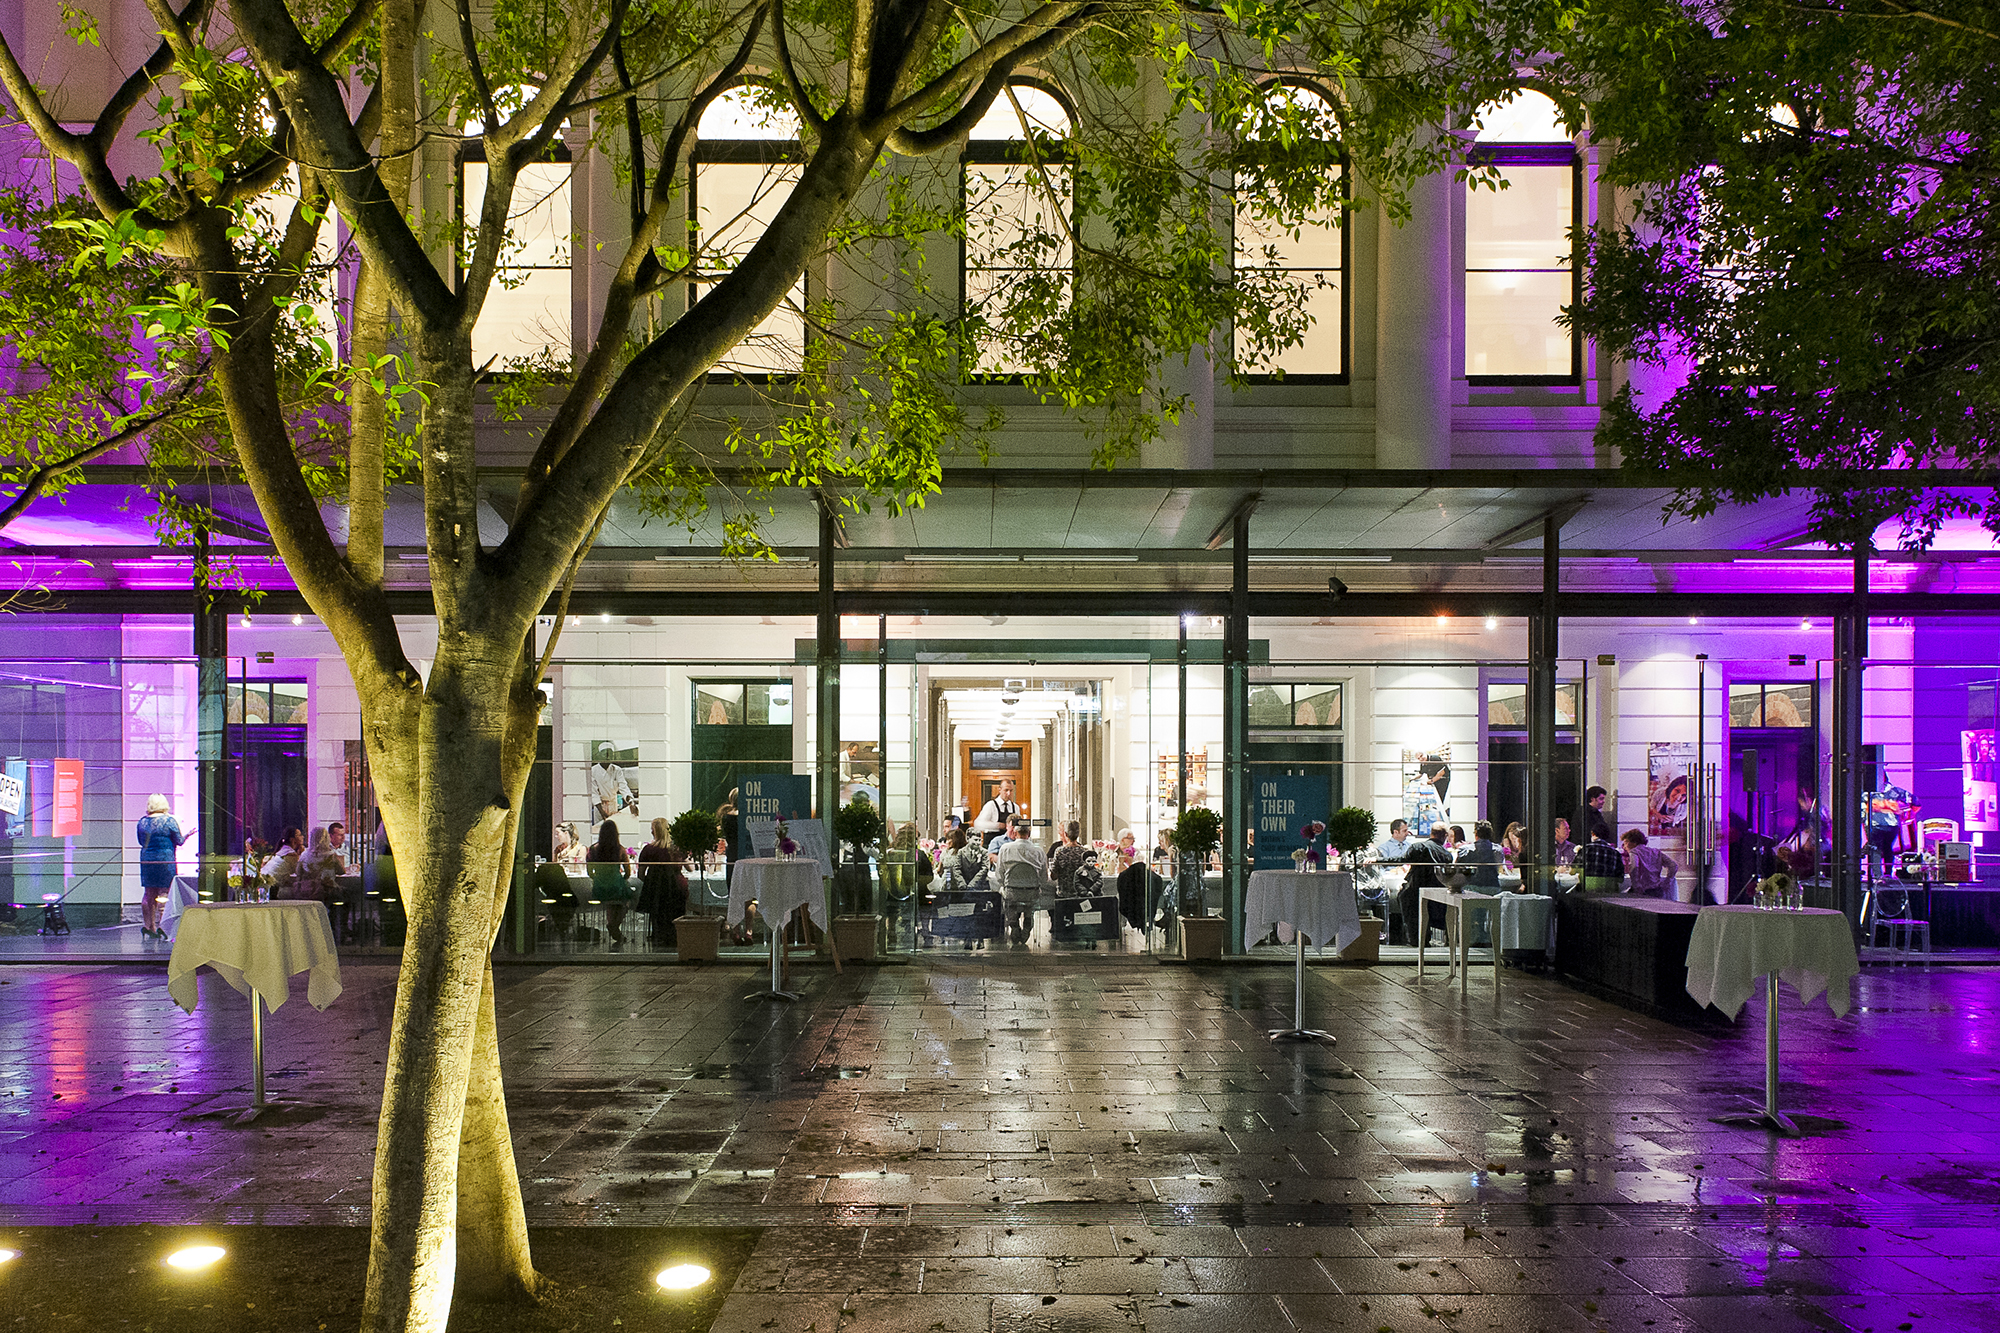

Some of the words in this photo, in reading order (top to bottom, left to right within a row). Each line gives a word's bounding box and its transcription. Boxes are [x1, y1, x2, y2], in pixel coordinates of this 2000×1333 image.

[0, 778, 20, 798] OPEN
[745, 781, 761, 796] ON
[1261, 782, 1277, 797] ON
[745, 799, 780, 813] THEIR
[1261, 800, 1295, 814] THEIR
[1261, 816, 1286, 832] OWN
